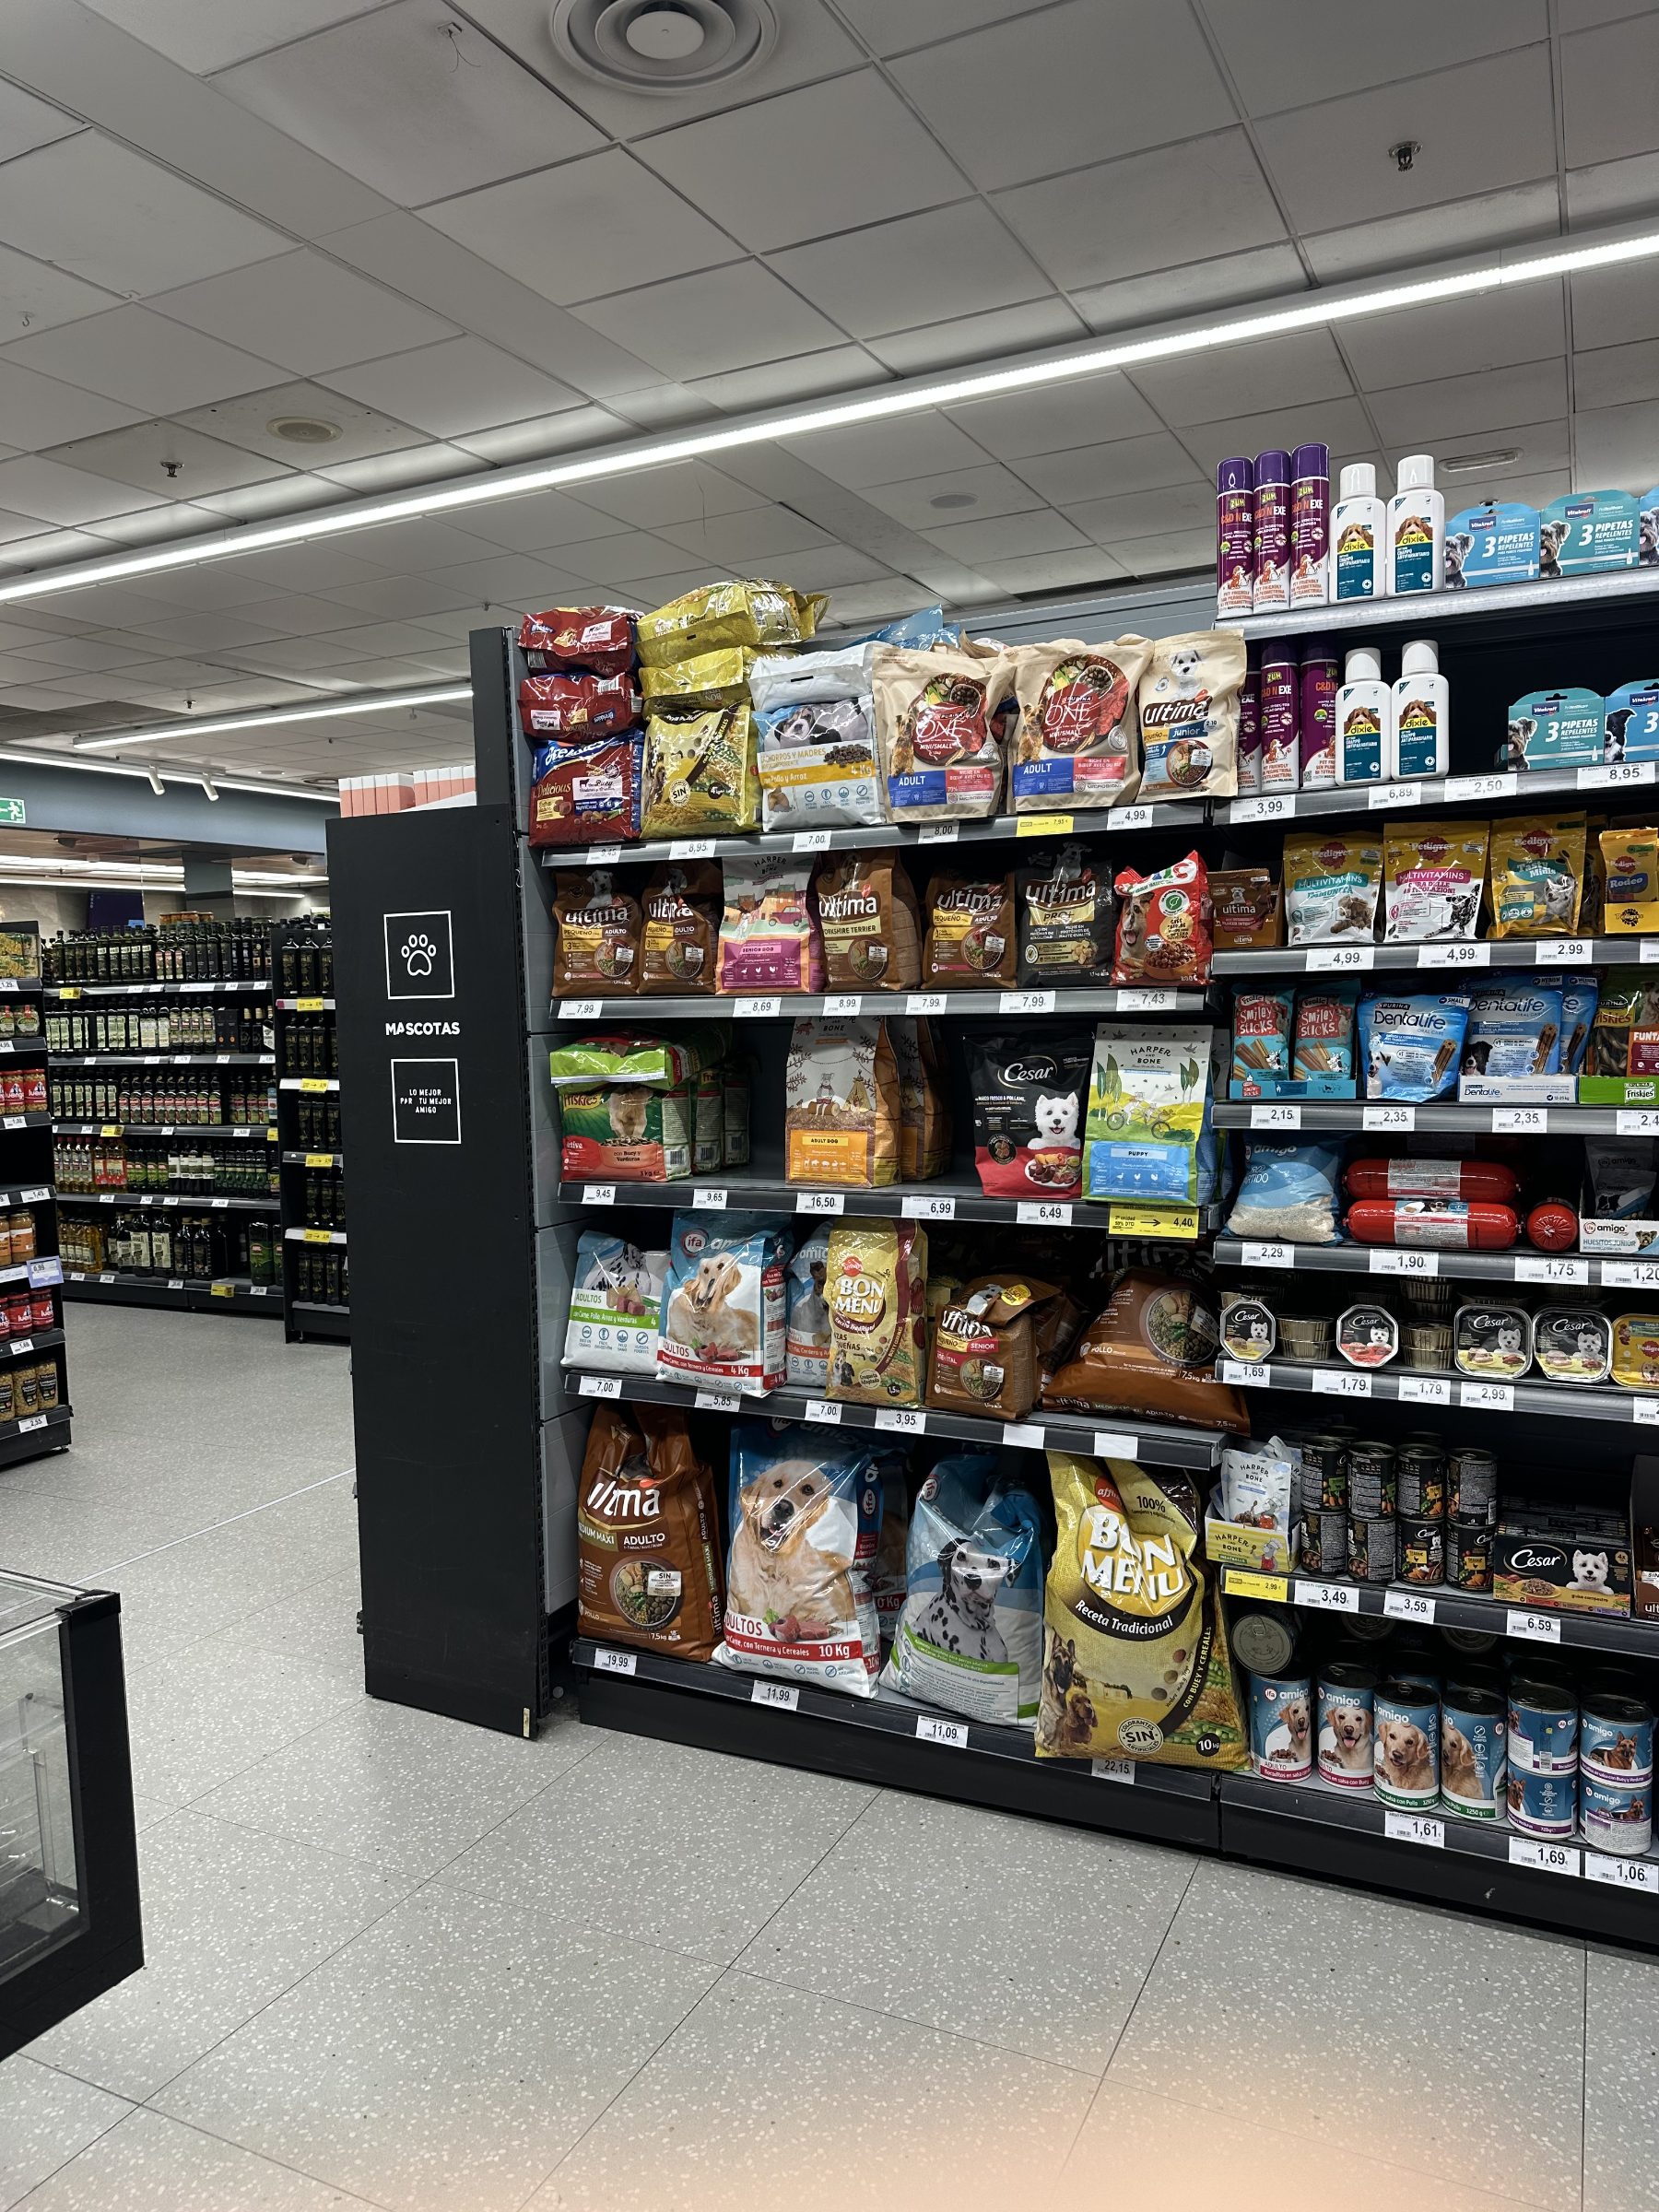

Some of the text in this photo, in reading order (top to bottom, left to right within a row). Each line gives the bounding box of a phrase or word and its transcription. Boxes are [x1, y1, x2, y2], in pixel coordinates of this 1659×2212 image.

[1579, 520, 1633, 546] 3 PIPETAS
[1594, 529, 1632, 539] REPELENTES
[1402, 535, 1425, 545] dixie
[1482, 532, 1535, 558] 3 PIPETAS
[1498, 541, 1534, 551] REPELENTES
[1344, 542, 1366, 551] dixie
[1145, 700, 1208, 724] ultima
[1406, 719, 1429, 727] dixie
[1644, 712, 1658, 733] 3
[1172, 727, 1200, 738] junior
[1350, 725, 1372, 735] dixie
[1546, 718, 1598, 742] 3 PIPETAS
[1560, 727, 1597, 735] REPELENTES
[797, 747, 826, 757] MADRES
[1024, 763, 1053, 775] ADULT
[790, 772, 807, 782] Arroz
[899, 776, 925, 786] ADULT
[673, 789, 687, 799] SIN
[754, 856, 787, 867] HARPER
[1298, 876, 1363, 889] MULTIVITAMINS
[1398, 872, 1465, 882] MULTIVITAMINS
[1610, 877, 1643, 888] Rodeo
[937, 889, 1002, 911] ultima
[1026, 880, 1096, 908] ultima
[819, 896, 877, 917] ultima
[1223, 905, 1256, 913] ultima
[1373, 1010, 1446, 1030] Dentalife
[385, 1022, 460, 1036] MASCOTAS
[1130, 1046, 1171, 1057] HARPER
[1005, 1063, 1053, 1082] Cesar
[1465, 1088, 1500, 1096] Dentalife
[1627, 1088, 1653, 1099] Friskies
[1597, 1225, 1626, 1234] amigo
[688, 1238, 702, 1248] ifa
[840, 1277, 884, 1299] BON
[575, 1293, 602, 1303] ADULTOS
[618, 1316, 637, 1324] Verduras
[651, 1318, 656, 1326] 4
[1235, 1311, 1260, 1321] Cesar
[1352, 1316, 1379, 1326] Cesar
[1474, 1314, 1509, 1329] Cesar
[1552, 1319, 1588, 1333] Cesar
[705, 1365, 749, 1376] Cereales 4 Kg
[1241, 1464, 1269, 1477] HARPER
[1245, 1475, 1263, 1483] BONE
[1136, 1496, 1166, 1512] 100%
[596, 1532, 665, 1546] MAXI ADULTO
[1090, 1512, 1176, 1571] BON
[1215, 1534, 1249, 1547] HARPER
[1222, 1544, 1242, 1552] BONE
[1511, 1549, 1560, 1568] Cesar
[1081, 1550, 1185, 1601] MENU
[887, 1595, 900, 1607] Kg
[1076, 1600, 1174, 1635] Receta Tradicional
[755, 1642, 776, 1653] Ternera
[782, 1647, 809, 1656] Cereales
[819, 1645, 833, 1656] 10
[836, 1644, 849, 1658] Kg
[1182, 1697, 1194, 1708] con
[1190, 1673, 1203, 1695] BUEY
[1279, 1688, 1309, 1700] amigo
[1326, 1694, 1360, 1706] amigo
[1377, 1707, 1409, 1724] amigo
[1121, 1720, 1155, 1733] COLORANTES
[1588, 1723, 1613, 1737] amigo
[1125, 1731, 1155, 1743] SIN
[1198, 1739, 1212, 1751] 10
[1265, 1761, 1287, 1770] ADULTO
[1594, 1792, 1621, 1806] amigo
